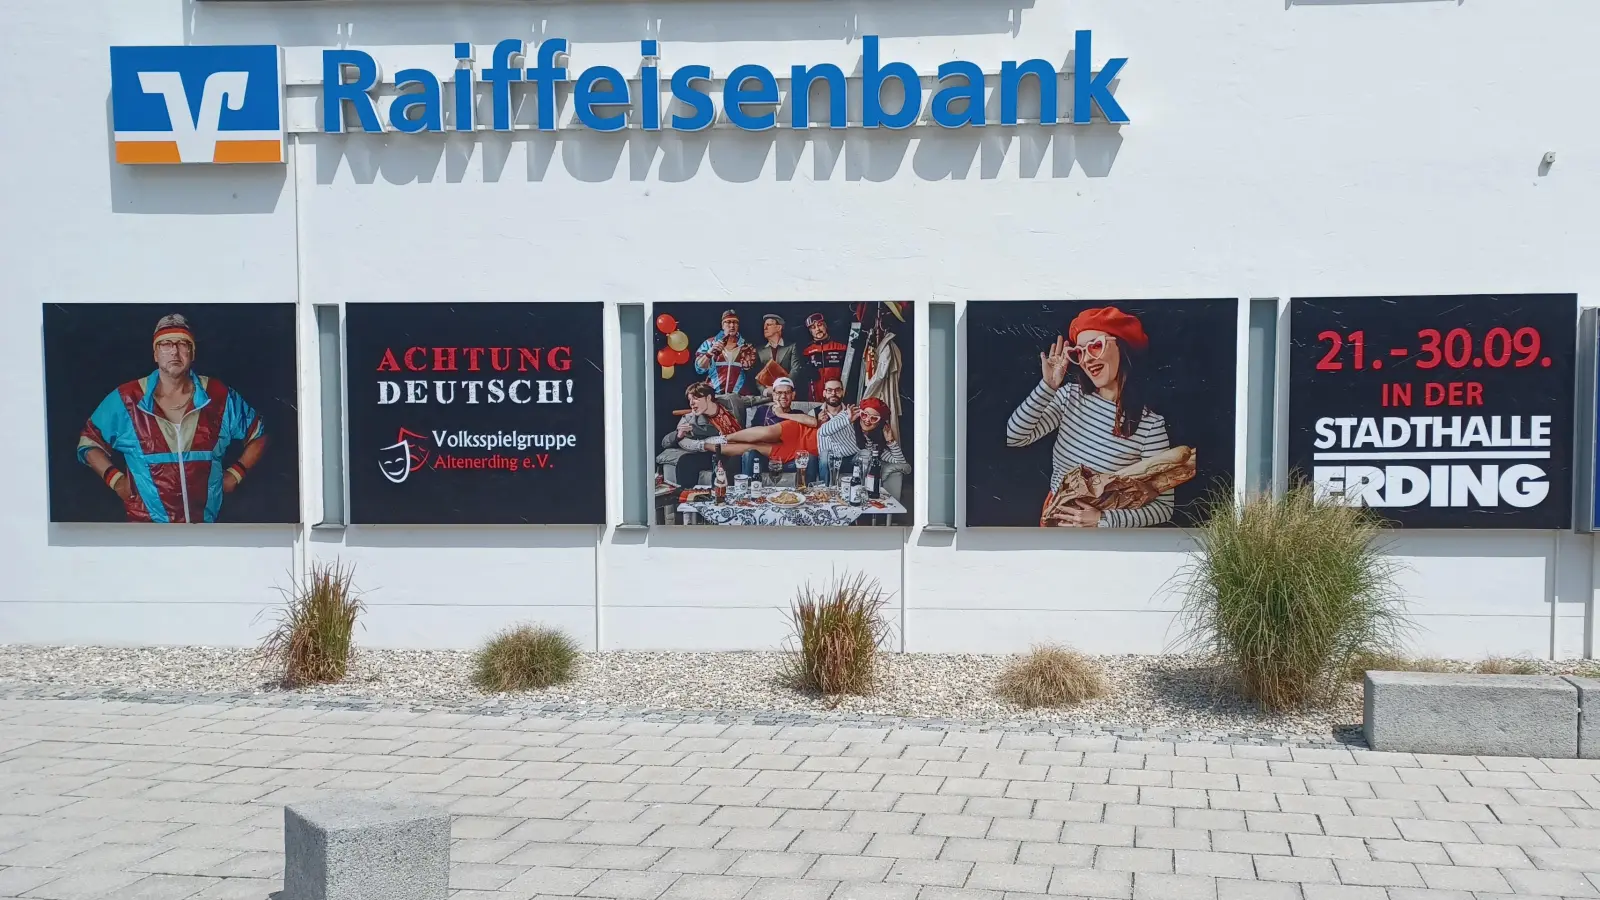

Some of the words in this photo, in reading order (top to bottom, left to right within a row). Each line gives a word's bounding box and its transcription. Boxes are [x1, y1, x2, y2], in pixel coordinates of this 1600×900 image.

[322, 29, 1130, 134] Raiffeisenbank
[376, 346, 573, 372] ACHTUNG
[376, 378, 575, 405] DEUTSCH!
[1381, 382, 1412, 407] IN
[1424, 381, 1484, 406] DER
[432, 430, 577, 451] Volksspielgruppe
[1313, 415, 1552, 449] STADTHALLE
[434, 454, 518, 472] Altenerding
[522, 454, 554, 469] e.V.
[1313, 463, 1551, 508] ERDING
